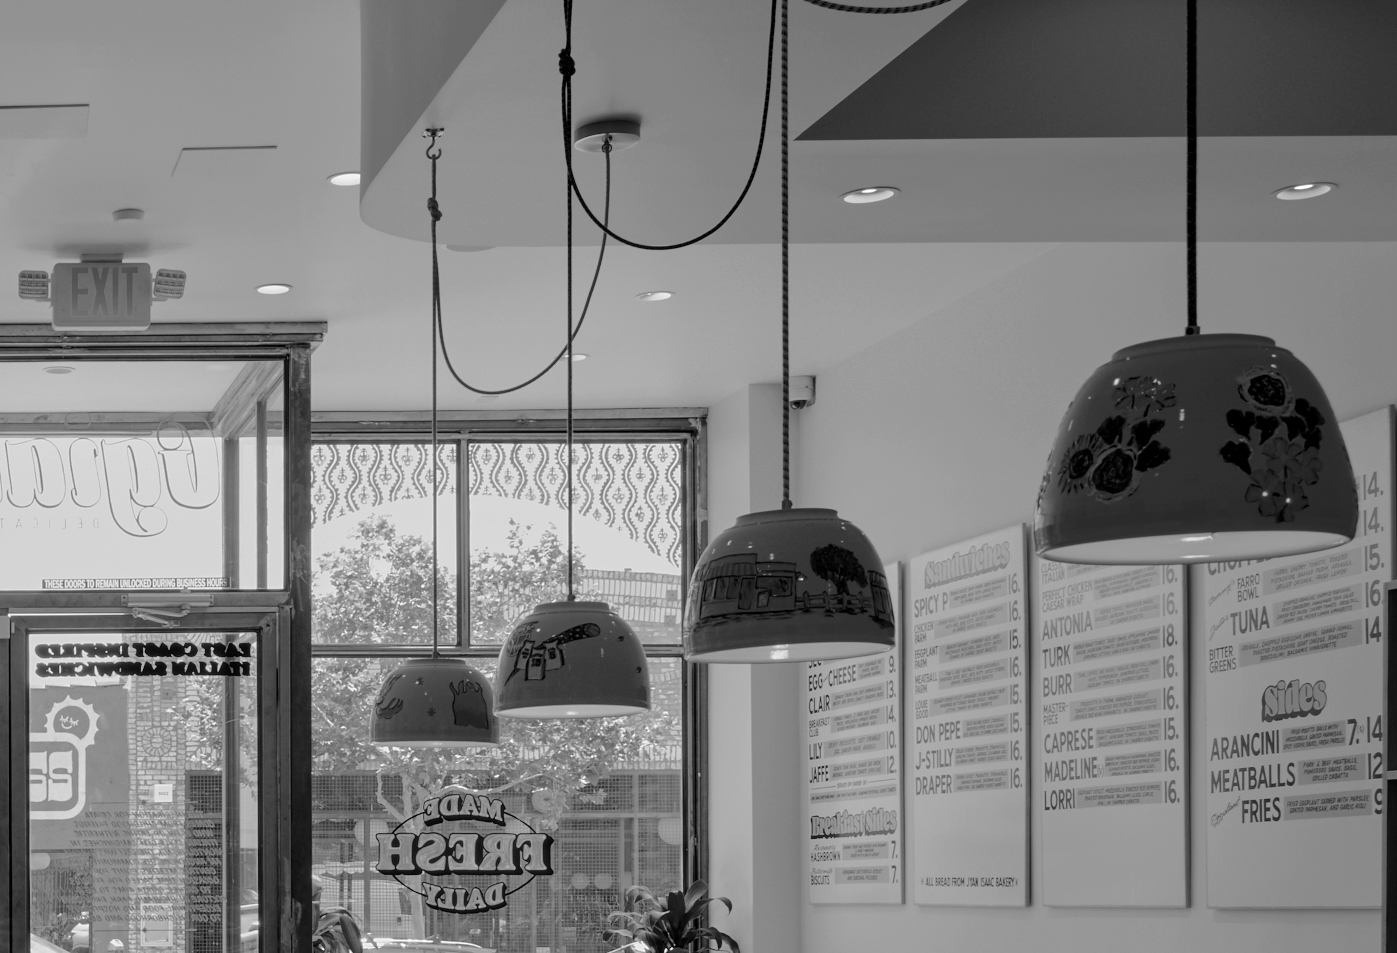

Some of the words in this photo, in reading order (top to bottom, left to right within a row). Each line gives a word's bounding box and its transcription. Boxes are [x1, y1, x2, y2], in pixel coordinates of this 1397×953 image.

[71, 267, 138, 317] EXIT
[1363, 471, 1384, 500] 14.
[1364, 507, 1384, 536] 14.
[924, 541, 1010, 589] Sandwiches
[1330, 554, 1348, 562] ROASTED
[1365, 543, 1384, 572] 15.
[45, 580, 64, 589] THESE
[65, 580, 85, 588] DOORS
[86, 579, 95, 588] TO
[96, 579, 119, 588] REMAIN
[120, 579, 151, 588] UNLOCKED
[153, 579, 175, 588] DURING
[177, 578, 205, 587] BUSINESS
[207, 578, 228, 587] HOURS
[1042, 570, 1065, 585] ITALIAN
[1237, 574, 1260, 588] FARRO
[914, 594, 940, 618] SPICY
[943, 592, 948, 610] P
[1008, 573, 1020, 594] 16.
[1042, 587, 1065, 602] PERFECT
[1067, 580, 1092, 595] CHICKEN
[1237, 588, 1259, 602] BOWL
[1009, 600, 1021, 622] 16.
[1042, 600, 1064, 612] CAESAR
[1066, 595, 1084, 607] WRAP
[914, 621, 934, 634] CHICKEN
[1042, 611, 1093, 641] ANTONIA
[1162, 592, 1178, 616] 16.
[1230, 605, 1270, 636] TUNA
[915, 634, 927, 644] PARM
[1009, 628, 1021, 650] 15.
[1042, 644, 1071, 669] TURK
[1162, 623, 1178, 648] 18.
[1328, 632, 1348, 640] ROASTED
[915, 646, 938, 659] EGGPLANT
[1209, 646, 1233, 660] BITTER
[1287, 647, 1308, 656] BALSAMIC
[888, 655, 896, 673] 9.
[915, 659, 927, 669] PARM
[1009, 656, 1022, 678] 16.
[1209, 659, 1236, 673] GREENS
[915, 672, 938, 684] MEATBALL
[1043, 673, 1072, 697] BURR
[1163, 655, 1178, 678] 16.
[809, 694, 830, 714] CLAIR
[886, 680, 896, 699] 13.
[915, 684, 927, 694] PARM
[1009, 684, 1022, 705] 15.
[1163, 686, 1179, 710] 16.
[915, 700, 928, 710] LOUIE
[1043, 703, 1069, 715] MASTER-
[1262, 679, 1327, 722] Sides
[809, 717, 830, 729] BREAKFAST
[886, 705, 896, 723] 14.
[916, 710, 928, 719] GOOD
[1044, 714, 1058, 726] PIECE
[809, 728, 819, 737] CLUB
[916, 724, 935, 744] DON
[939, 721, 960, 741] PEPE
[1010, 712, 1022, 733] 15.
[1044, 728, 1094, 754] CAPRESE
[1164, 717, 1179, 740] 15.
[809, 742, 822, 760] LILY
[886, 730, 896, 749] 10.
[915, 748, 954, 770] J-STILLY
[1010, 740, 1023, 761] 16.
[1210, 730, 1280, 761] ARANCINI
[810, 765, 829, 783] JAFFE
[886, 756, 897, 774] 12.
[1164, 748, 1180, 772] 16.
[916, 774, 952, 795] DRAPER
[1010, 768, 1023, 788] 16.
[1211, 762, 1296, 793] MEATBALLS
[1368, 752, 1383, 779] 12
[1044, 789, 1075, 810] LORRI
[1165, 780, 1180, 804] 16.
[1241, 797, 1281, 823] FRIES
[811, 810, 864, 839] Breakfast
[865, 807, 897, 836] Sides
[810, 851, 841, 862] HASHBROWN
[891, 841, 898, 859] 7.
[811, 875, 830, 885] BISCUITS
[891, 865, 898, 883] 7.
[926, 877, 934, 887] ALL
[935, 877, 950, 887] BREAD
[952, 877, 965, 887] FROM
[980, 877, 994, 887] ISAAC
[996, 877, 1014, 887] BAKERY
